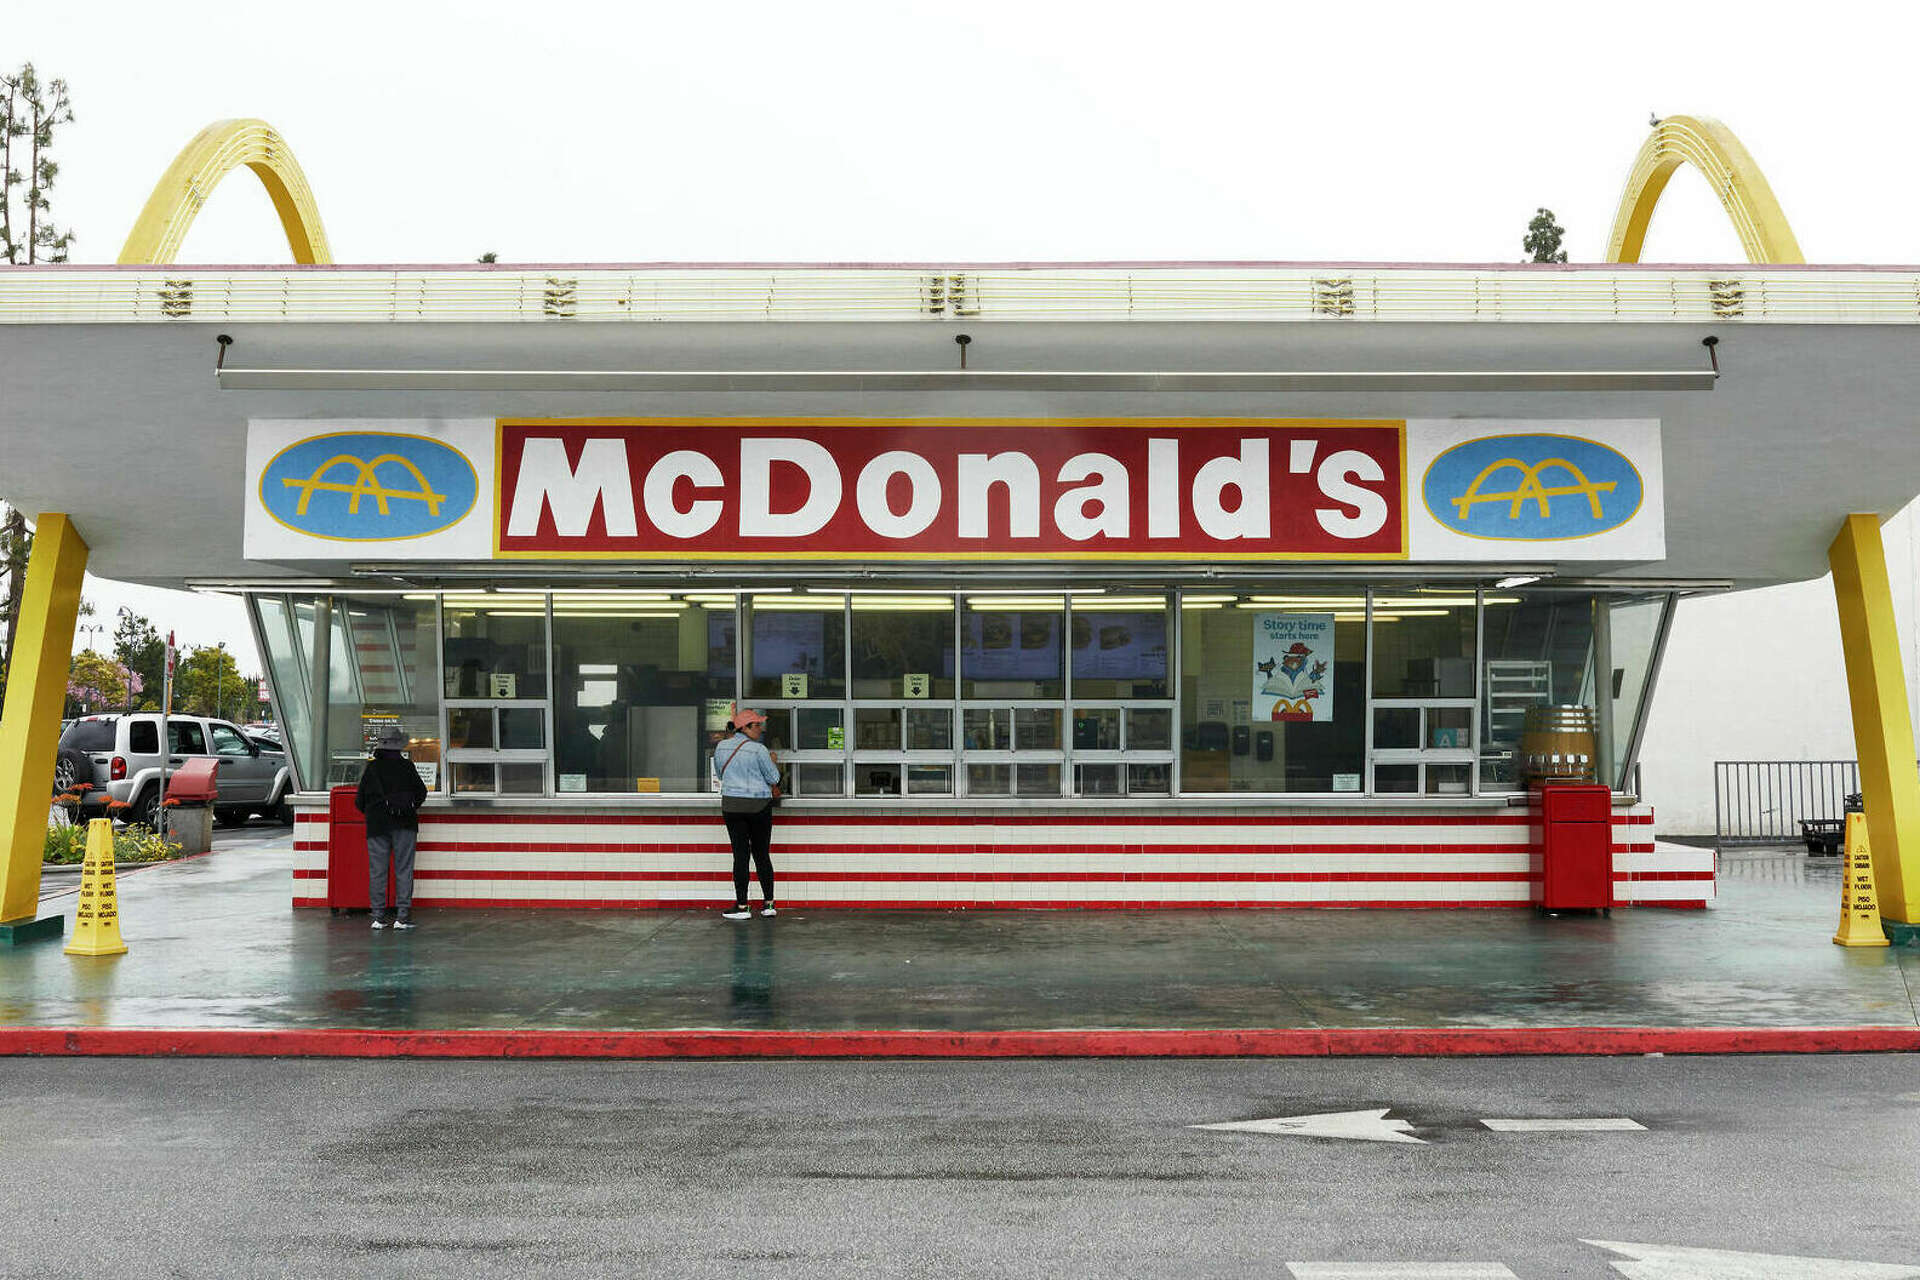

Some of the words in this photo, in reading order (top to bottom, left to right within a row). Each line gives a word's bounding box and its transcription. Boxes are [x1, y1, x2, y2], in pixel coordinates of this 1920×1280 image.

[506, 437, 1389, 540] McDonald's
[1263, 619, 1295, 632] Story
[1300, 619, 1328, 630] time
[1270, 632, 1297, 640] starts
[1300, 632, 1319, 640] here
